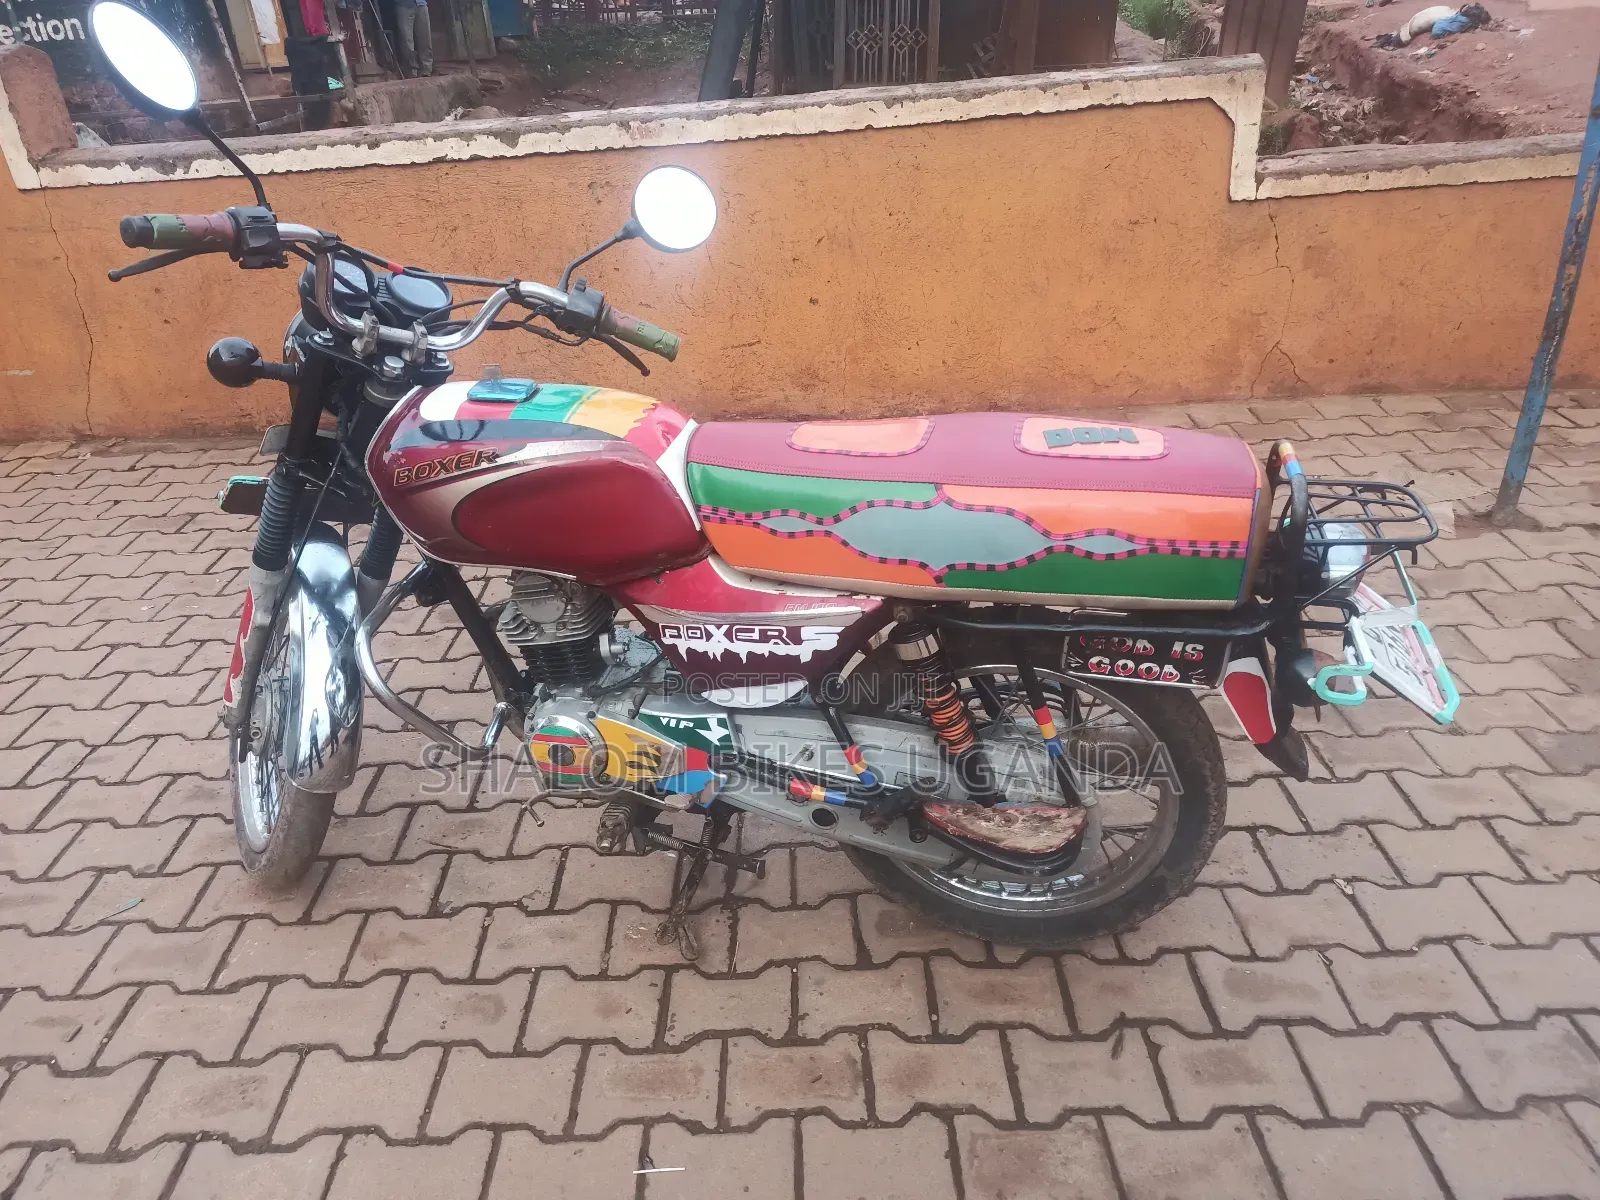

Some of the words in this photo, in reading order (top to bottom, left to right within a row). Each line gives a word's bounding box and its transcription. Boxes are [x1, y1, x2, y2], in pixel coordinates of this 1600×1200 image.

[1043, 427, 1140, 449] DON
[393, 446, 499, 487] BOXER
[658, 623, 796, 650] BOXER
[1170, 641, 1205, 661] IS
[1088, 655, 1181, 683] GOOD
[659, 716, 695, 729] VIP
